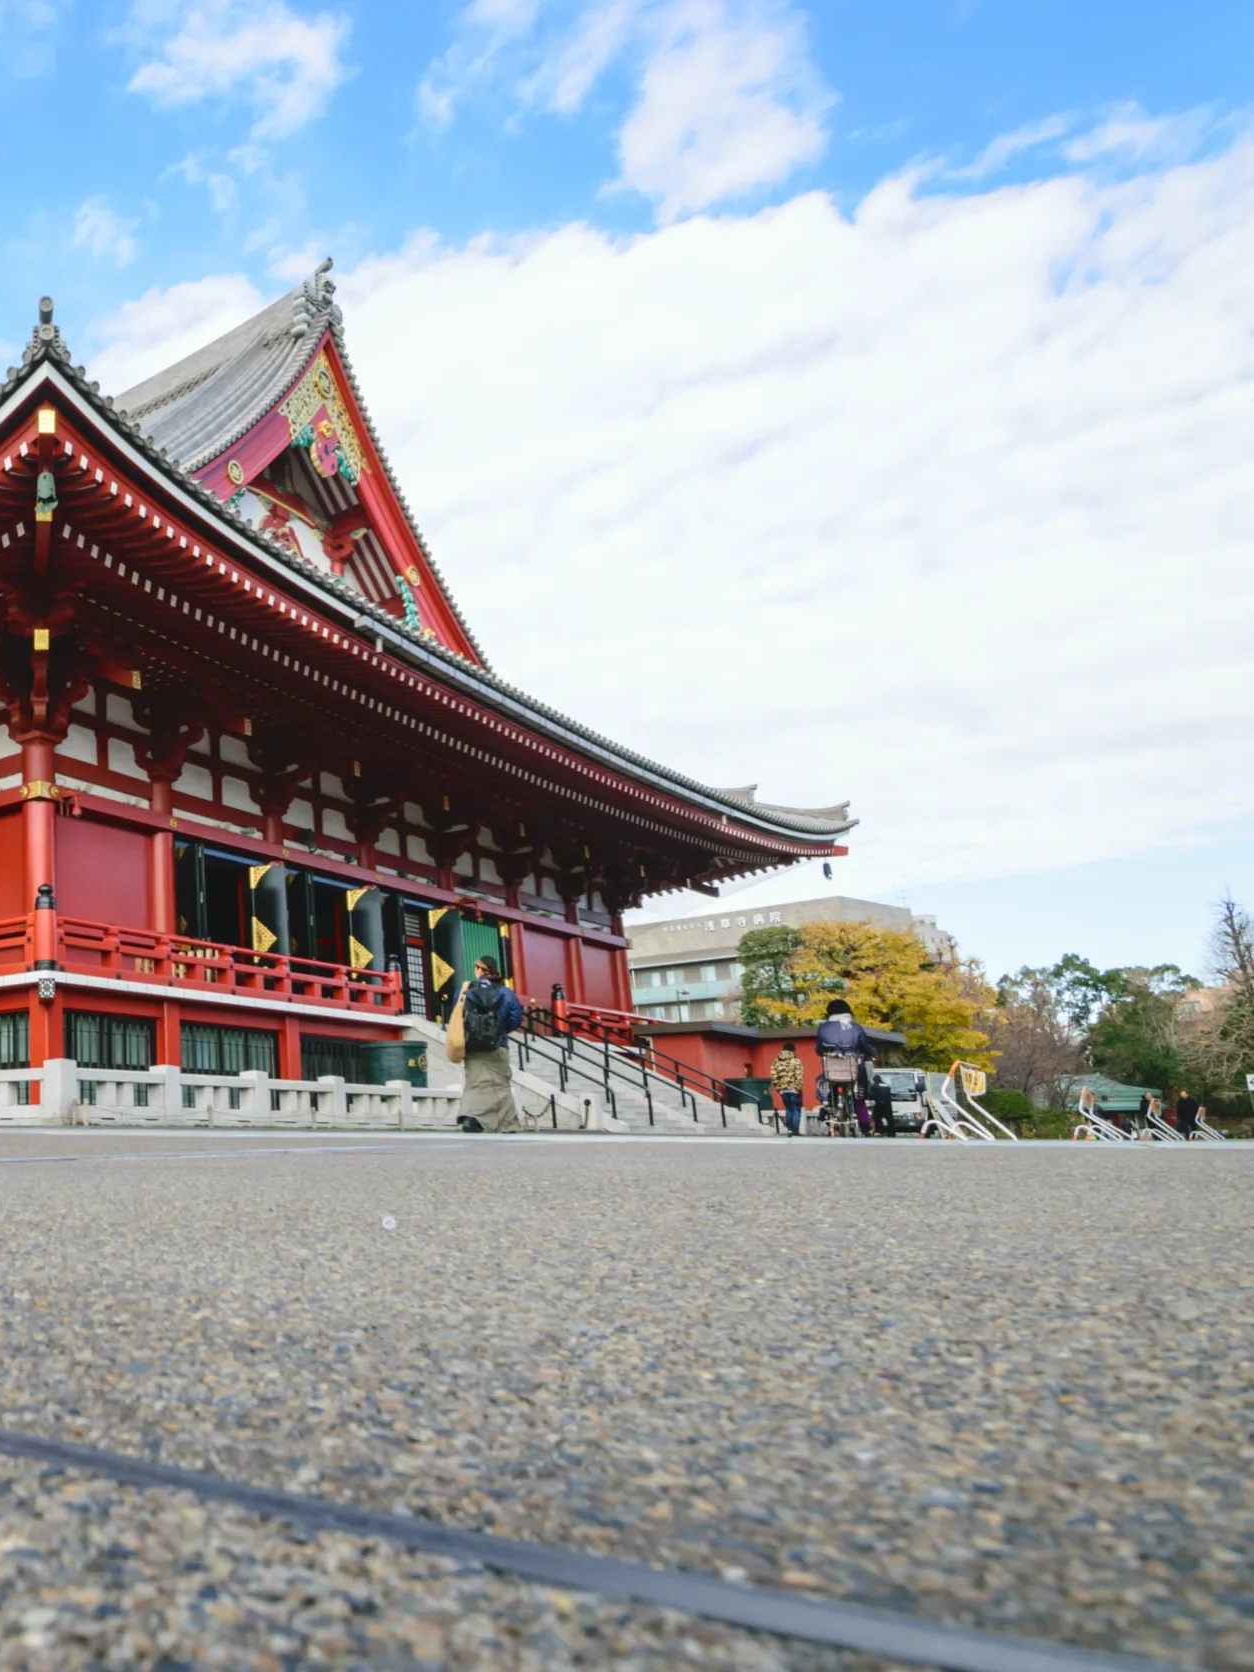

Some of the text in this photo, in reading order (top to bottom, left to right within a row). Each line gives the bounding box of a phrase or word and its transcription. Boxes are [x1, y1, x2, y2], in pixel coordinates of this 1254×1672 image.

[704, 911, 783, 932] 浅草寺病院
